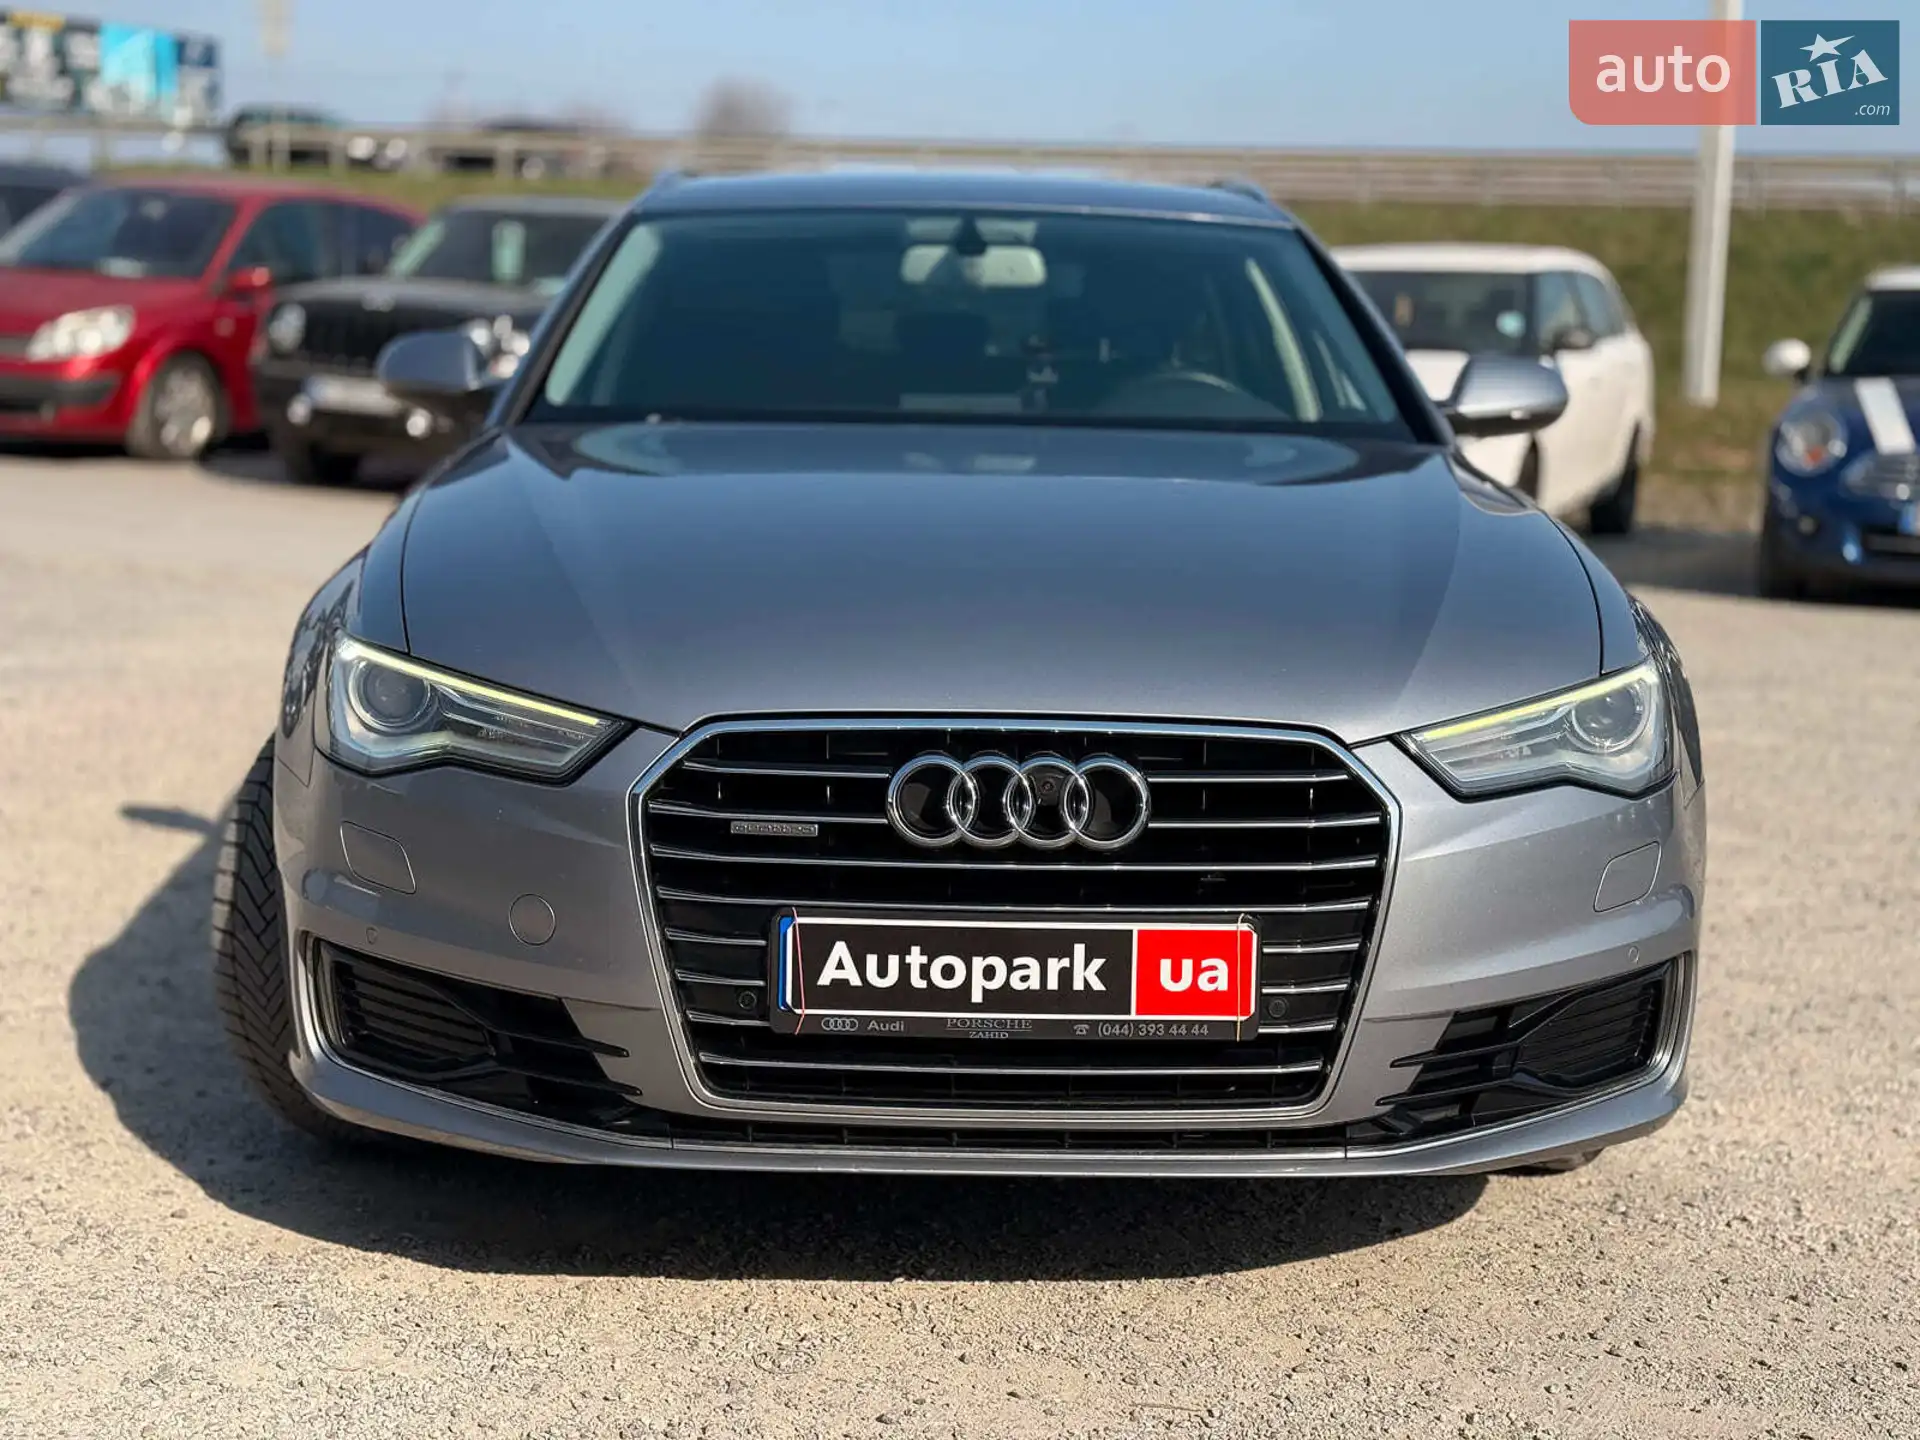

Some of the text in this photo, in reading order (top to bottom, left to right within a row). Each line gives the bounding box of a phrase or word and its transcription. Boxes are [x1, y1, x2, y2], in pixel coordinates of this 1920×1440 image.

[816, 940, 1230, 1004] Autopark ua
[866, 1019, 905, 1032] Audi
[947, 1018, 1033, 1030] PORSCHE
[1097, 1022, 1210, 1037] (044) 393 44 44
